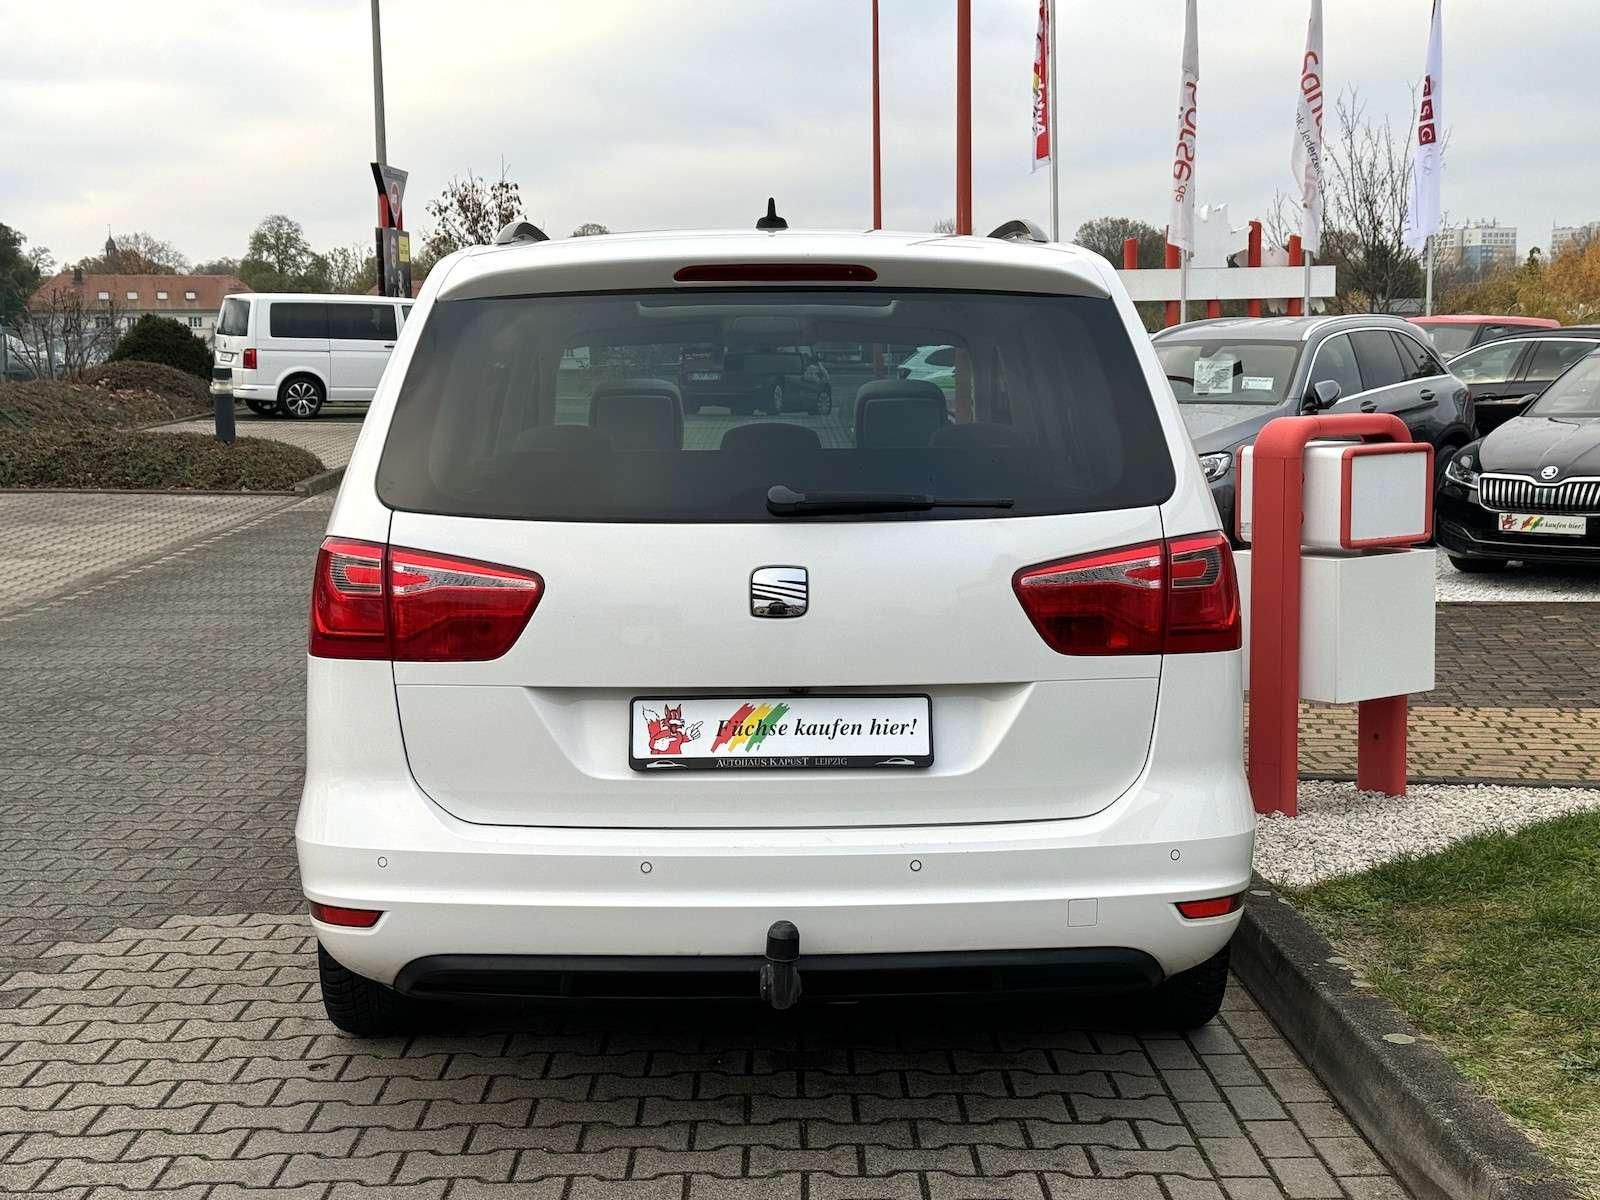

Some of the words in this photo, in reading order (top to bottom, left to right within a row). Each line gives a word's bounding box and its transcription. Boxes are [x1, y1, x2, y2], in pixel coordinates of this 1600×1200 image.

[716, 718, 788, 737] Füchse
[794, 717, 863, 740] kaufen
[869, 718, 918, 737] hier!
[815, 758, 848, 766] LEIPZIG
